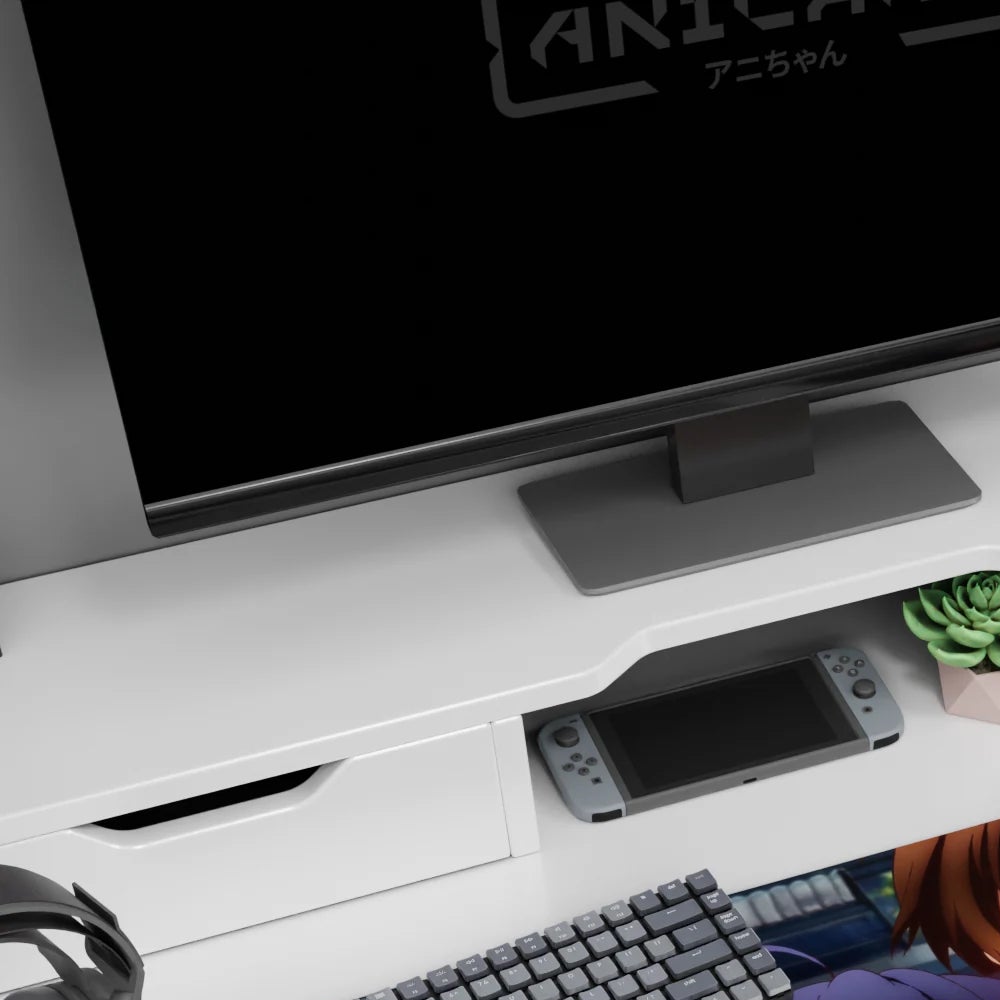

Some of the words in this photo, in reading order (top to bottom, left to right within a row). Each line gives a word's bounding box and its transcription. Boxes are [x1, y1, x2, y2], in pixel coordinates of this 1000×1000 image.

[704, 39, 848, 90] アニちゃん
